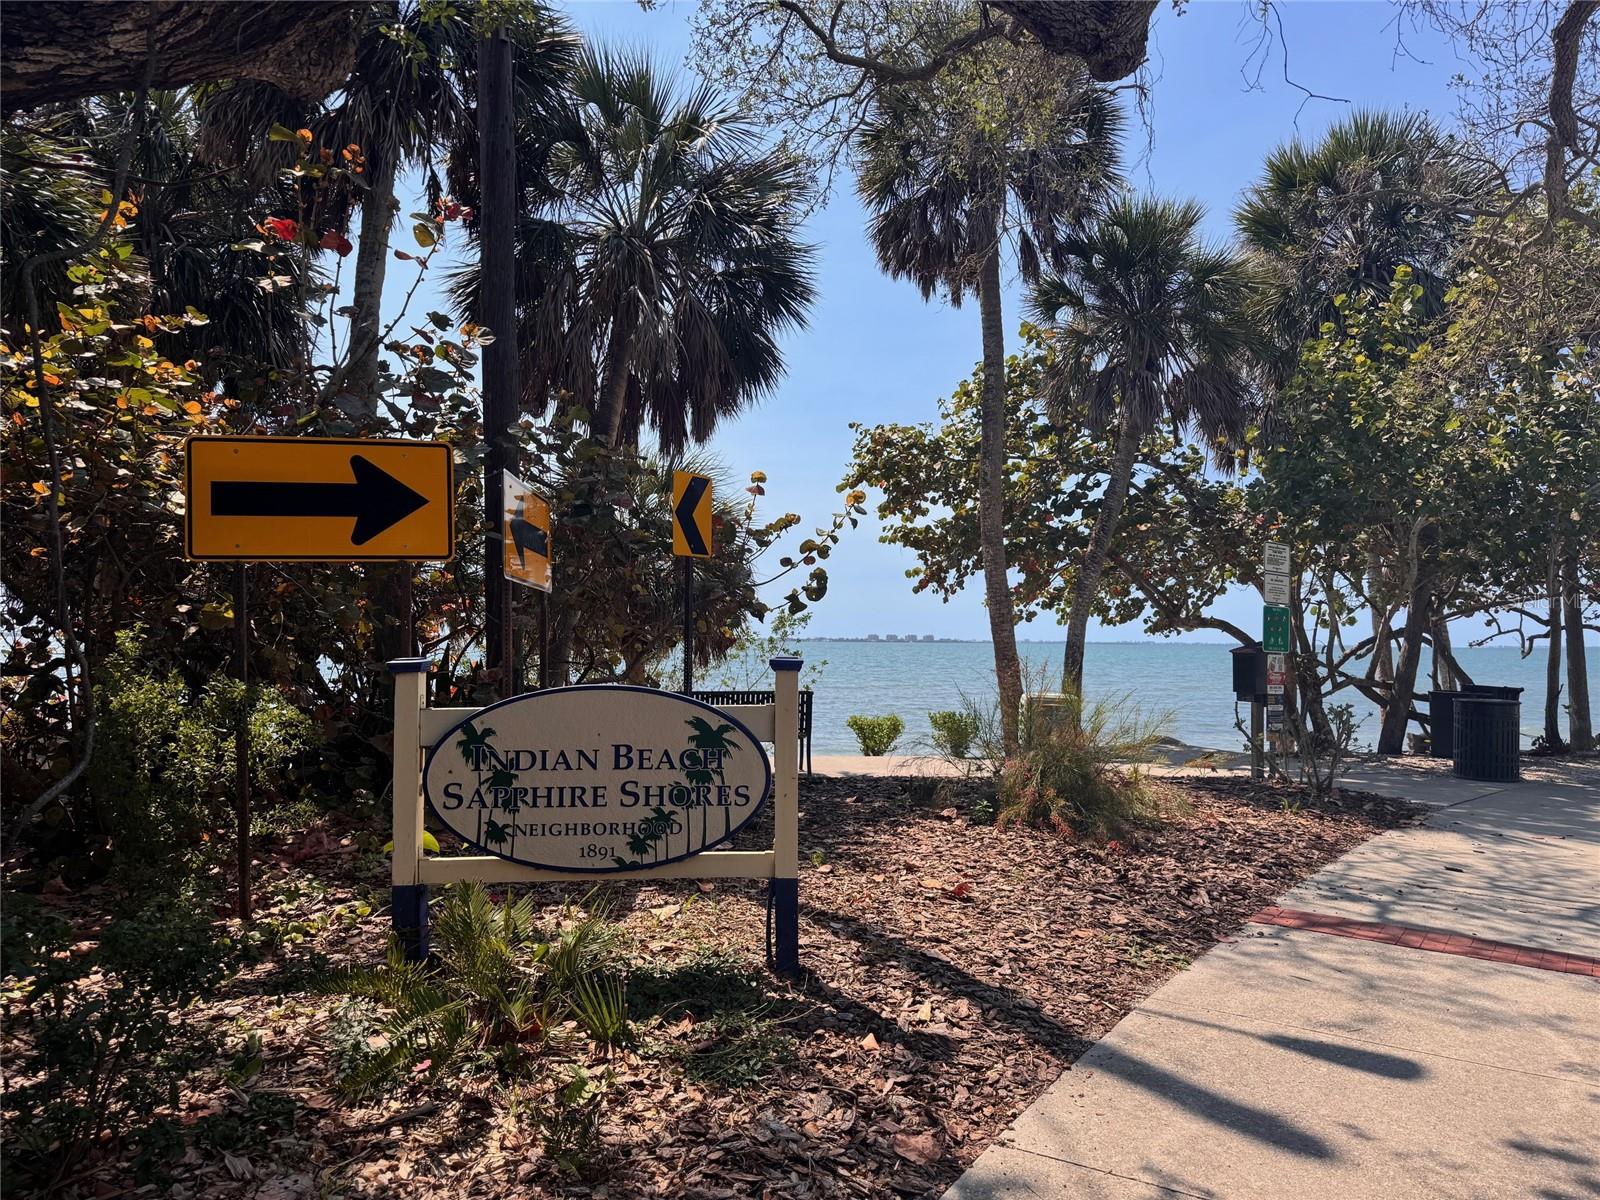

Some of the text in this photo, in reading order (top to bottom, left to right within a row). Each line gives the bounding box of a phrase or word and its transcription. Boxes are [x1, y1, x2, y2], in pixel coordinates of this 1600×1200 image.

[470, 744, 726, 773] INDIAN BEACH
[442, 780, 751, 810] SAPPHIRE SHORES
[513, 822, 683, 837] NEIGHBORHOOD
[578, 844, 616, 861] 1891
